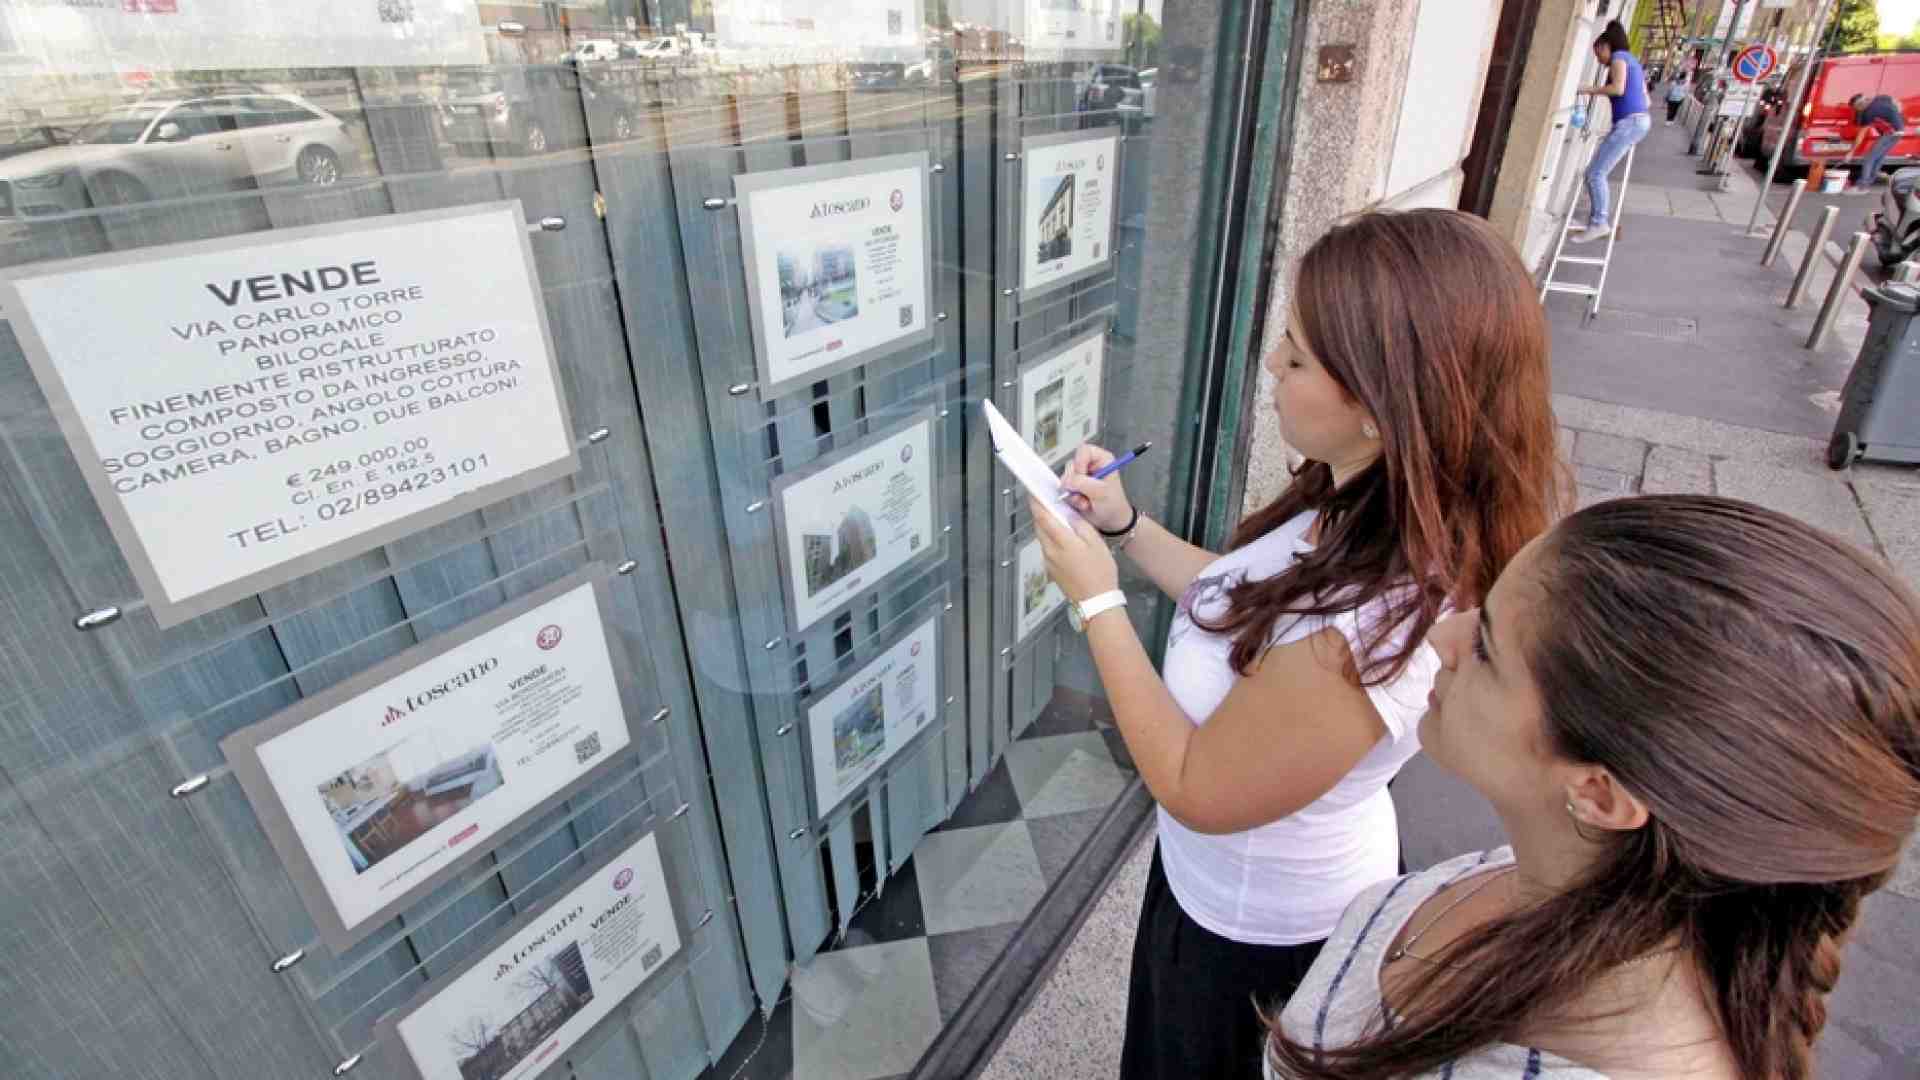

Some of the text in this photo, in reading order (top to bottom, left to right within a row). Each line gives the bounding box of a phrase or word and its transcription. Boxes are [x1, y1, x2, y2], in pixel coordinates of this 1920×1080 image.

[206, 261, 380, 306] VENDE
[171, 286, 423, 340] VIA CARLO TORRE
[217, 309, 402, 356] PANORAMICO
[110, 328, 495, 424] FINEMENTE RISTRUTTURATO
[256, 333, 384, 370] BILOCALE
[140, 389, 314, 440] COMPOSTO
[323, 379, 358, 398] DA
[311, 385, 414, 421] ANGOLO
[421, 359, 521, 392] COTTURA
[373, 401, 422, 425] DUE
[428, 376, 518, 410] BALCONI
[228, 453, 489, 548] TEL: 02/89423101
[285, 473, 303, 488] €
[365, 469, 379, 483] E
